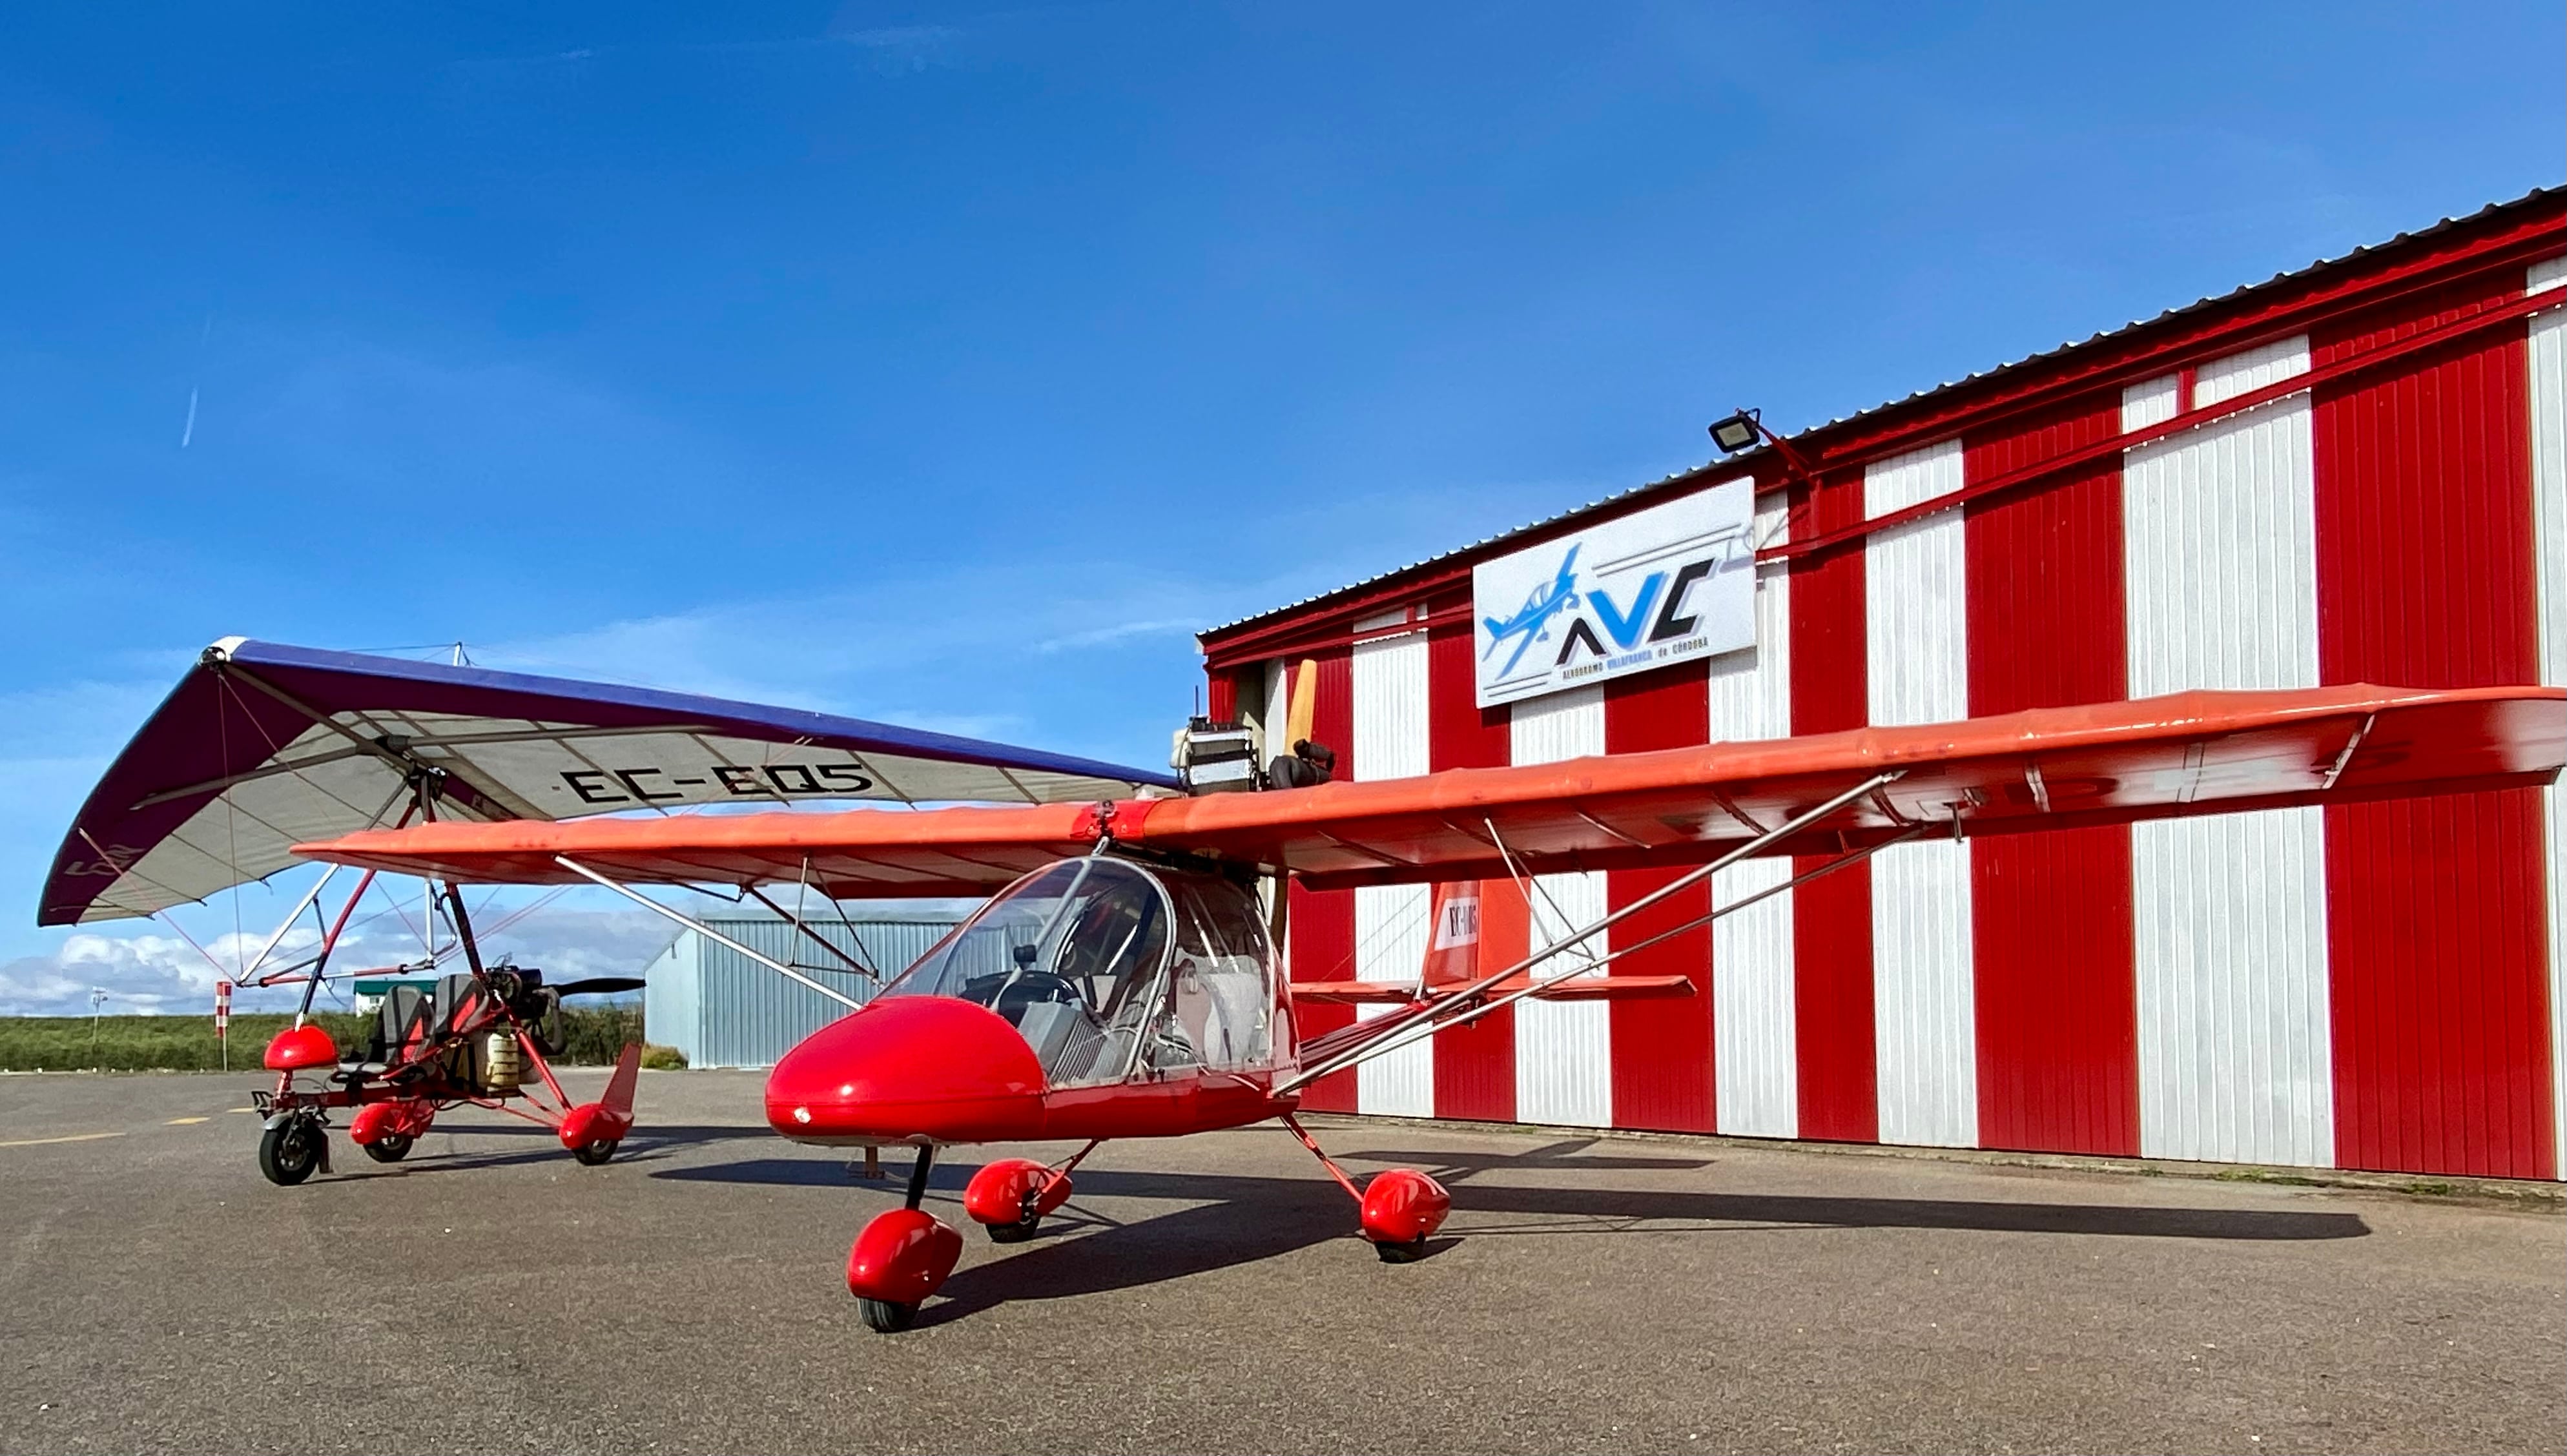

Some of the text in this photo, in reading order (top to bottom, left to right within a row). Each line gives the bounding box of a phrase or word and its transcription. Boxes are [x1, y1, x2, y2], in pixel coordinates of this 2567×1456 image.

[1555, 557, 1716, 666] AVC
[1607, 650, 1653, 670] VILLAFRANCA
[1658, 647, 1667, 657] de
